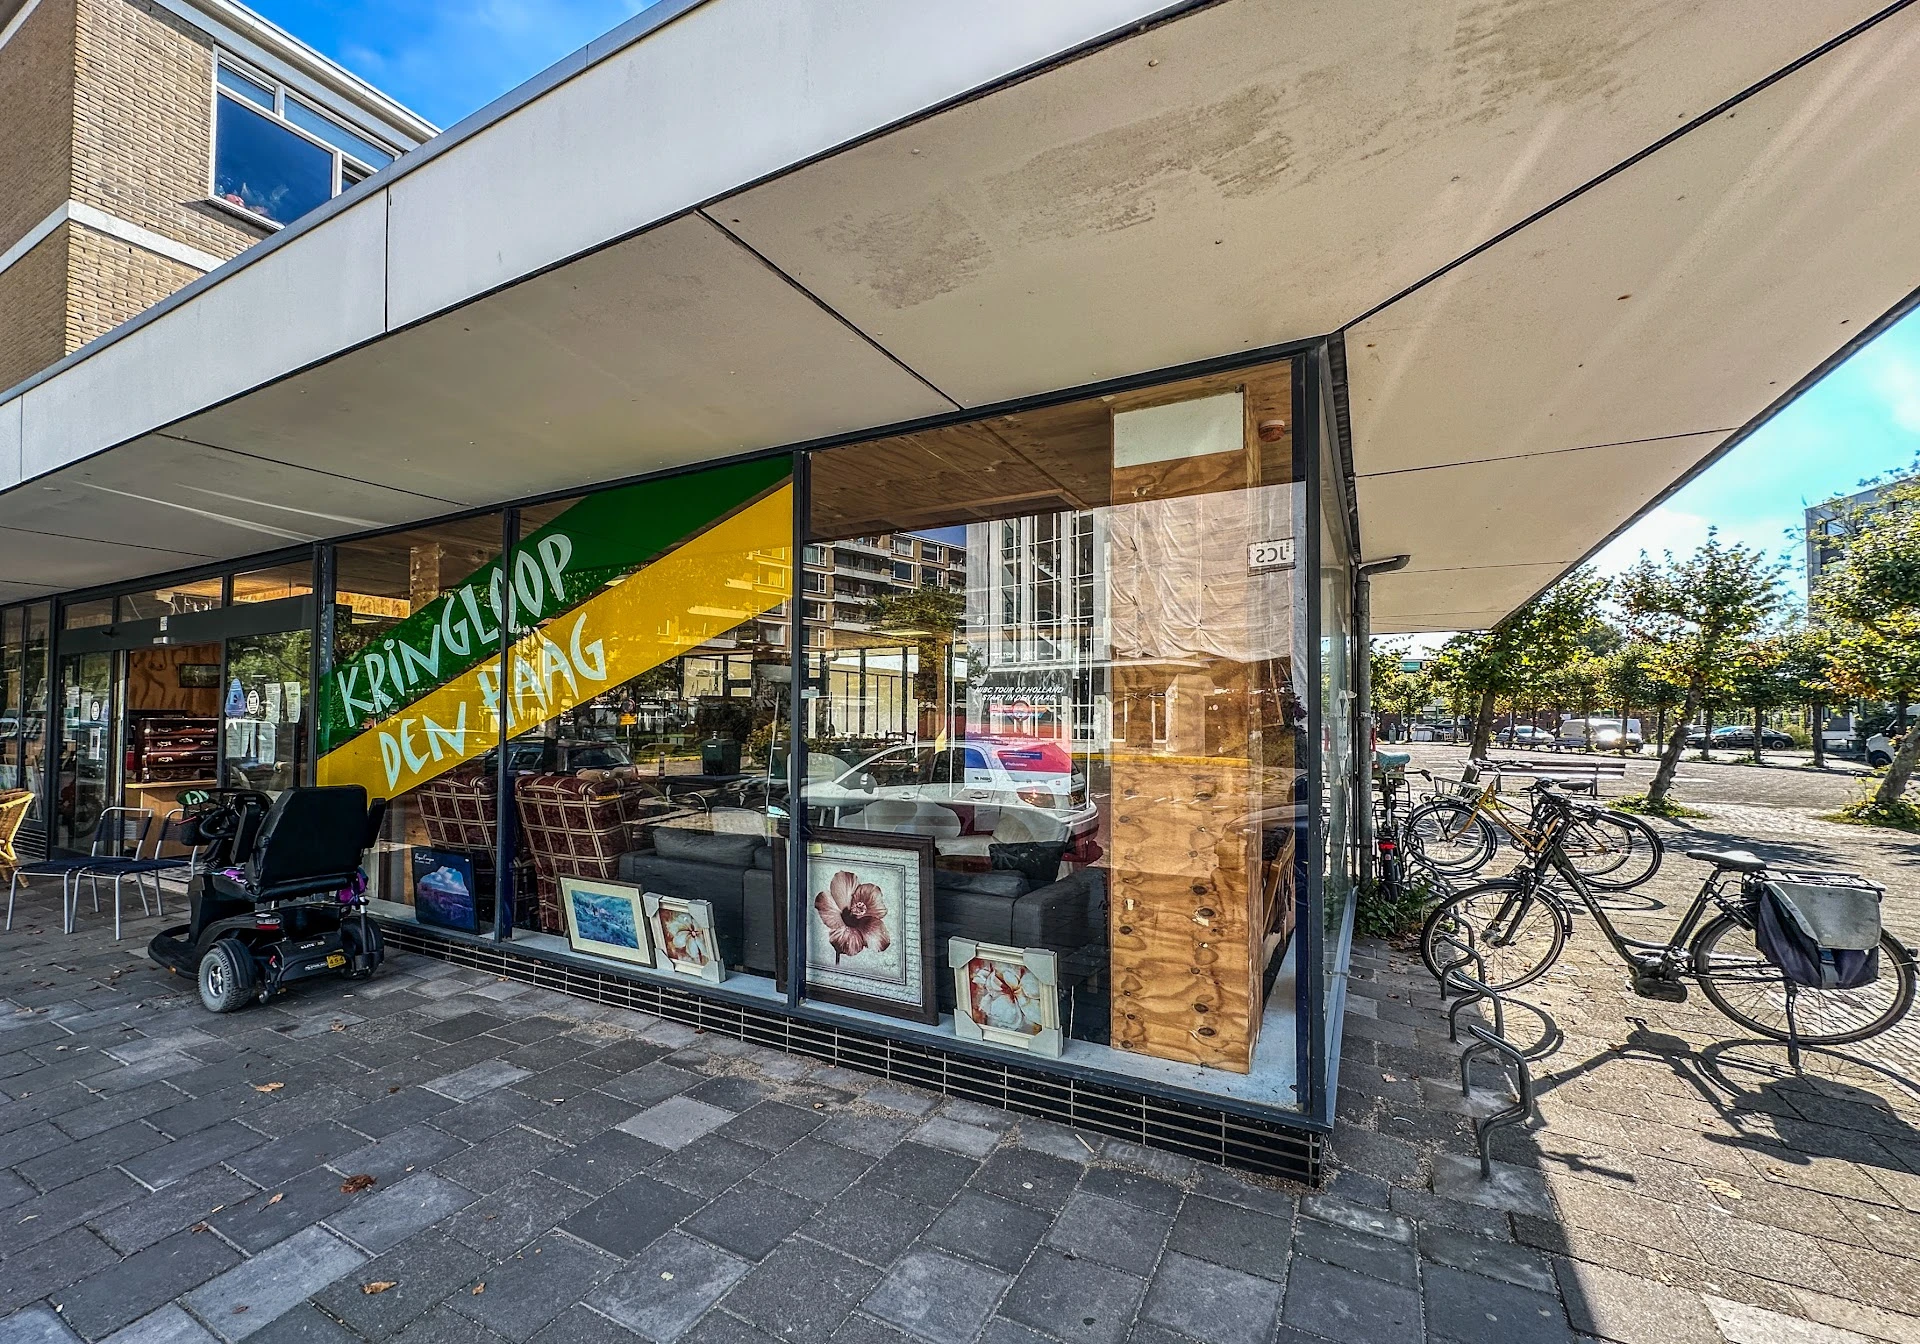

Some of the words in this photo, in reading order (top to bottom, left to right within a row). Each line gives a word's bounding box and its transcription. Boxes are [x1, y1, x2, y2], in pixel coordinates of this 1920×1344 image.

[994, 686, 1015, 694] TOUR
[1015, 686, 1026, 694] OF
[1026, 686, 1065, 694] HOLLAND
[378, 700, 467, 792] DEN
[476, 611, 608, 732] HAAG
[1014, 694, 1032, 702] DEN
